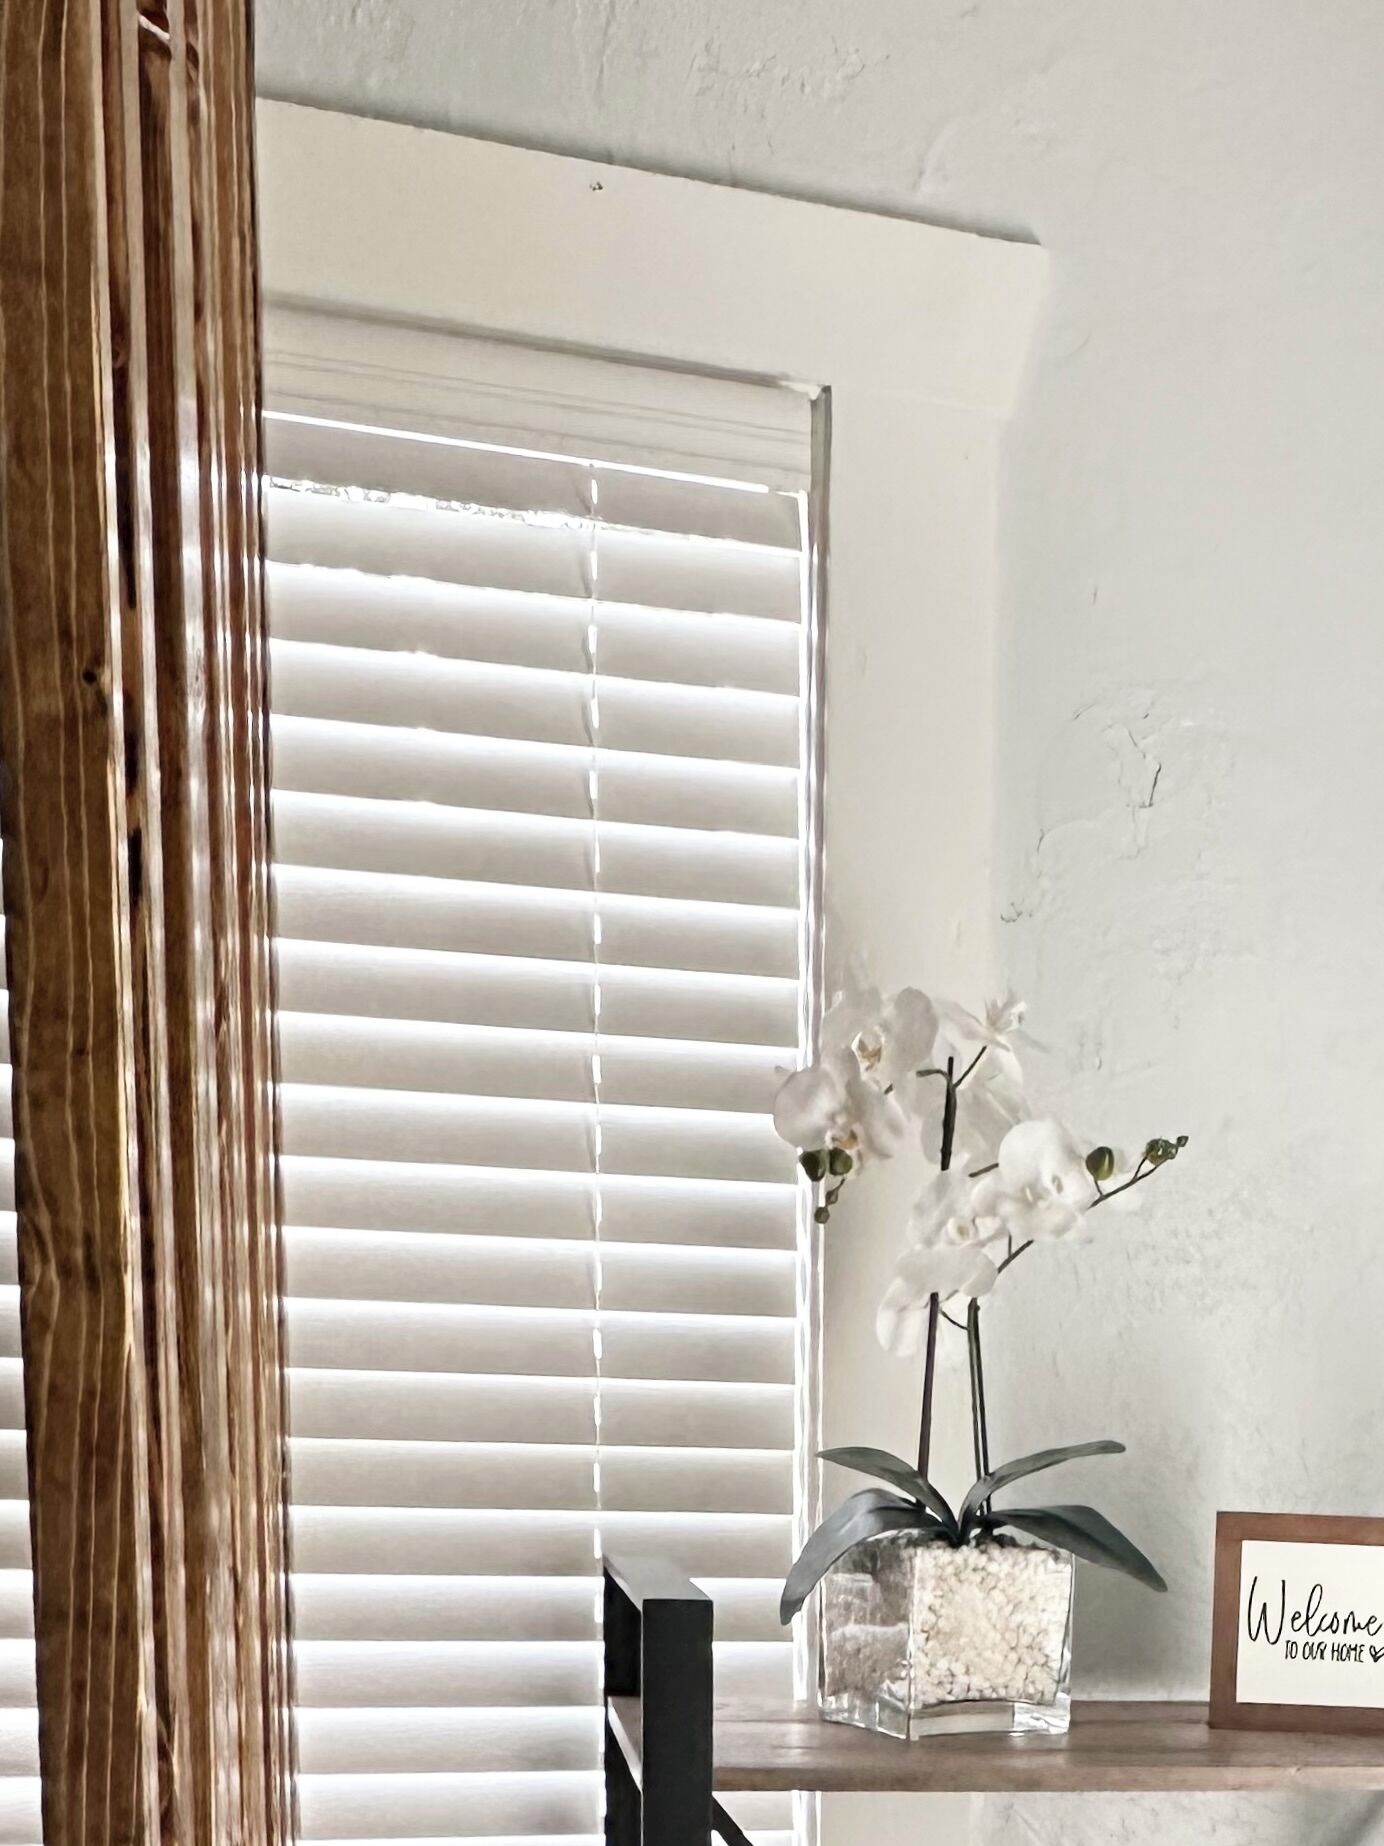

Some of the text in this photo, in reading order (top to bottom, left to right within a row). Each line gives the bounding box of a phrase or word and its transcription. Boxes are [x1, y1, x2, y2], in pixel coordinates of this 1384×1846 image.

[1248, 1576, 1383, 1645] Welcome
[1285, 1640, 1364, 1662] TO OUR HOME
